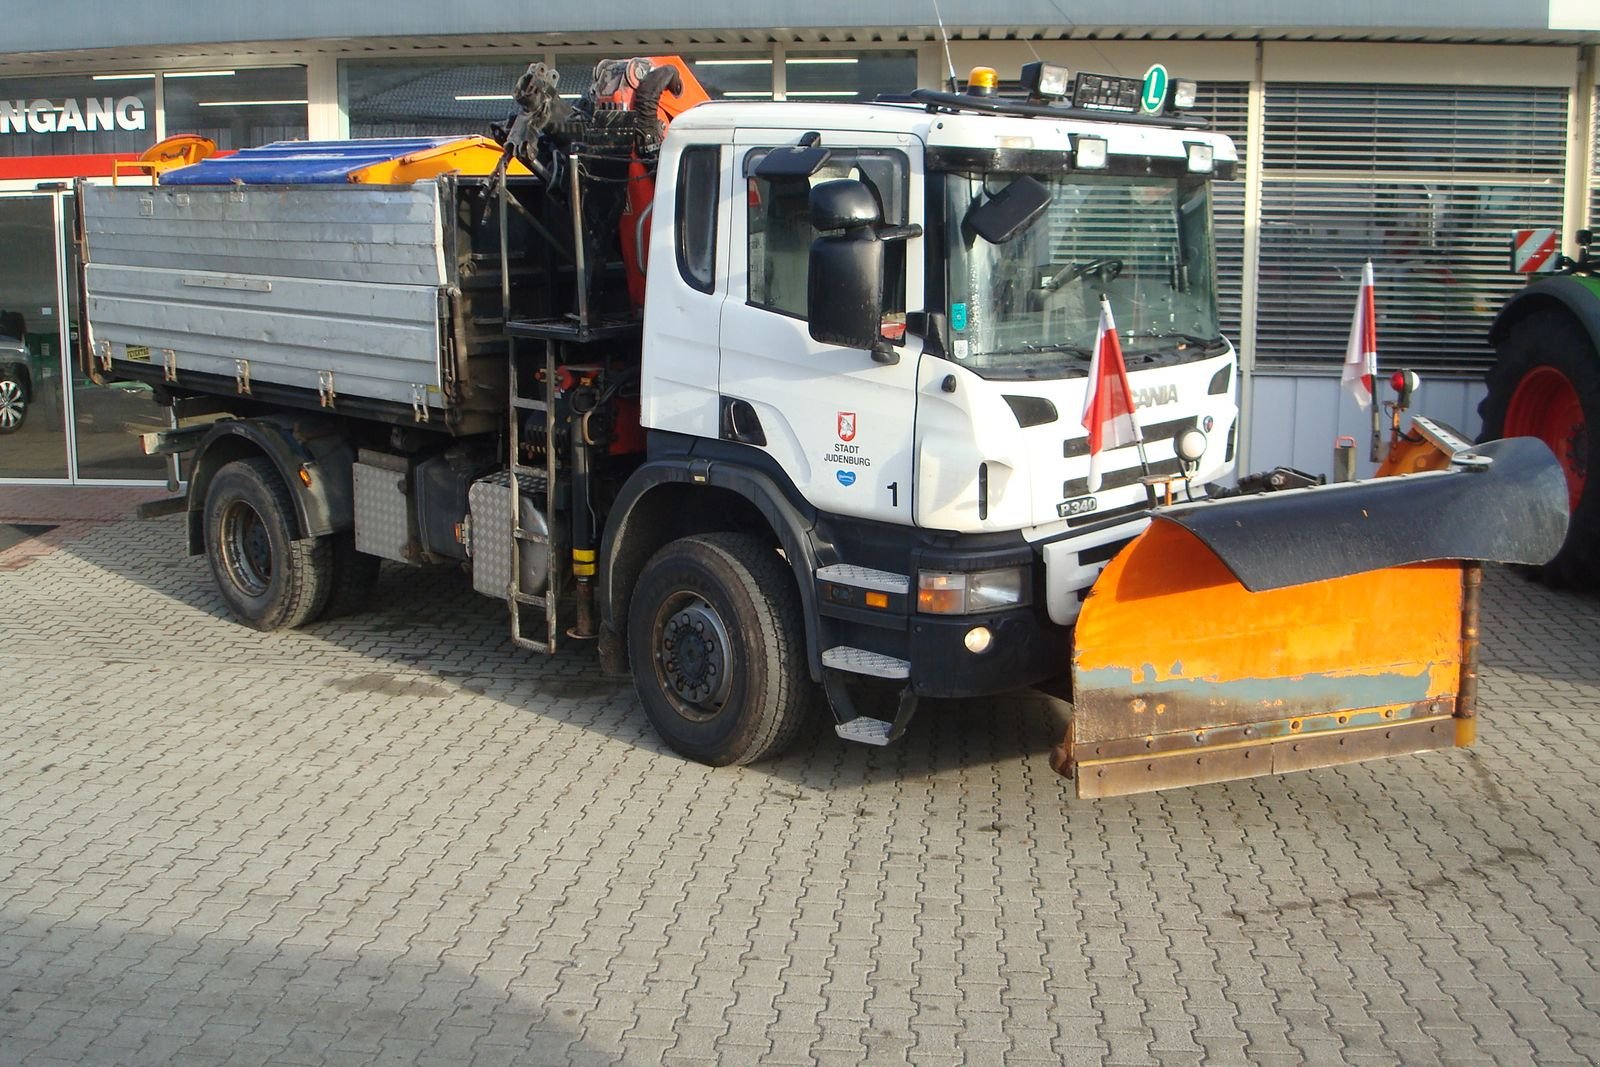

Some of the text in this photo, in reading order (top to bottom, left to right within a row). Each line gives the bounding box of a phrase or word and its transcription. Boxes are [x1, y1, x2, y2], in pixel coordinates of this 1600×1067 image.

[1147, 71, 1160, 104] L
[0, 96, 146, 133] NGANG
[1132, 382, 1179, 409] ANIA
[824, 453, 871, 467] JUDENBURG
[834, 443, 860, 454] STADT
[887, 481, 898, 507] 1
